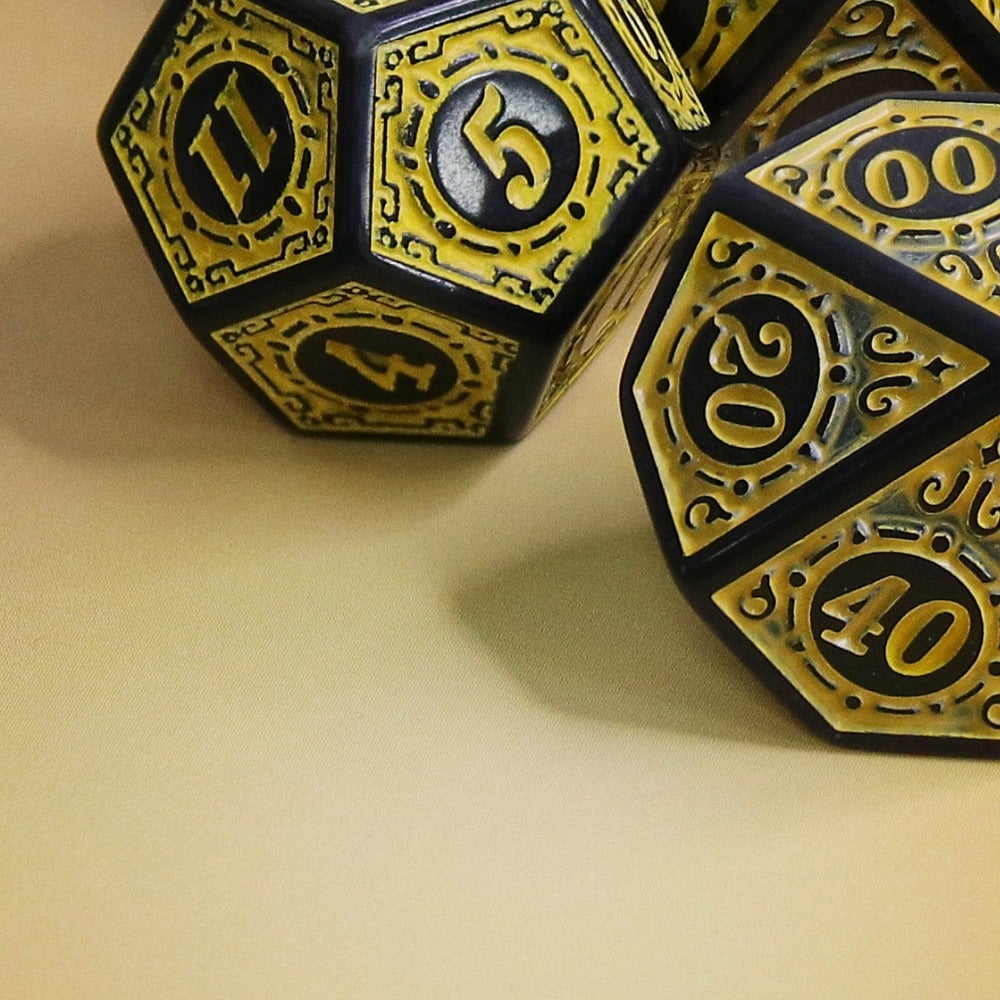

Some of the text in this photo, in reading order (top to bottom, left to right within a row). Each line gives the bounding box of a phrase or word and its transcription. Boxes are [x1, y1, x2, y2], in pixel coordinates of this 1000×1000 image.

[188, 68, 278, 215] 11
[462, 81, 552, 210] 5
[864, 137, 996, 208] 00
[325, 340, 439, 392] 4
[705, 314, 792, 449] 20
[821, 575, 970, 676] 40
